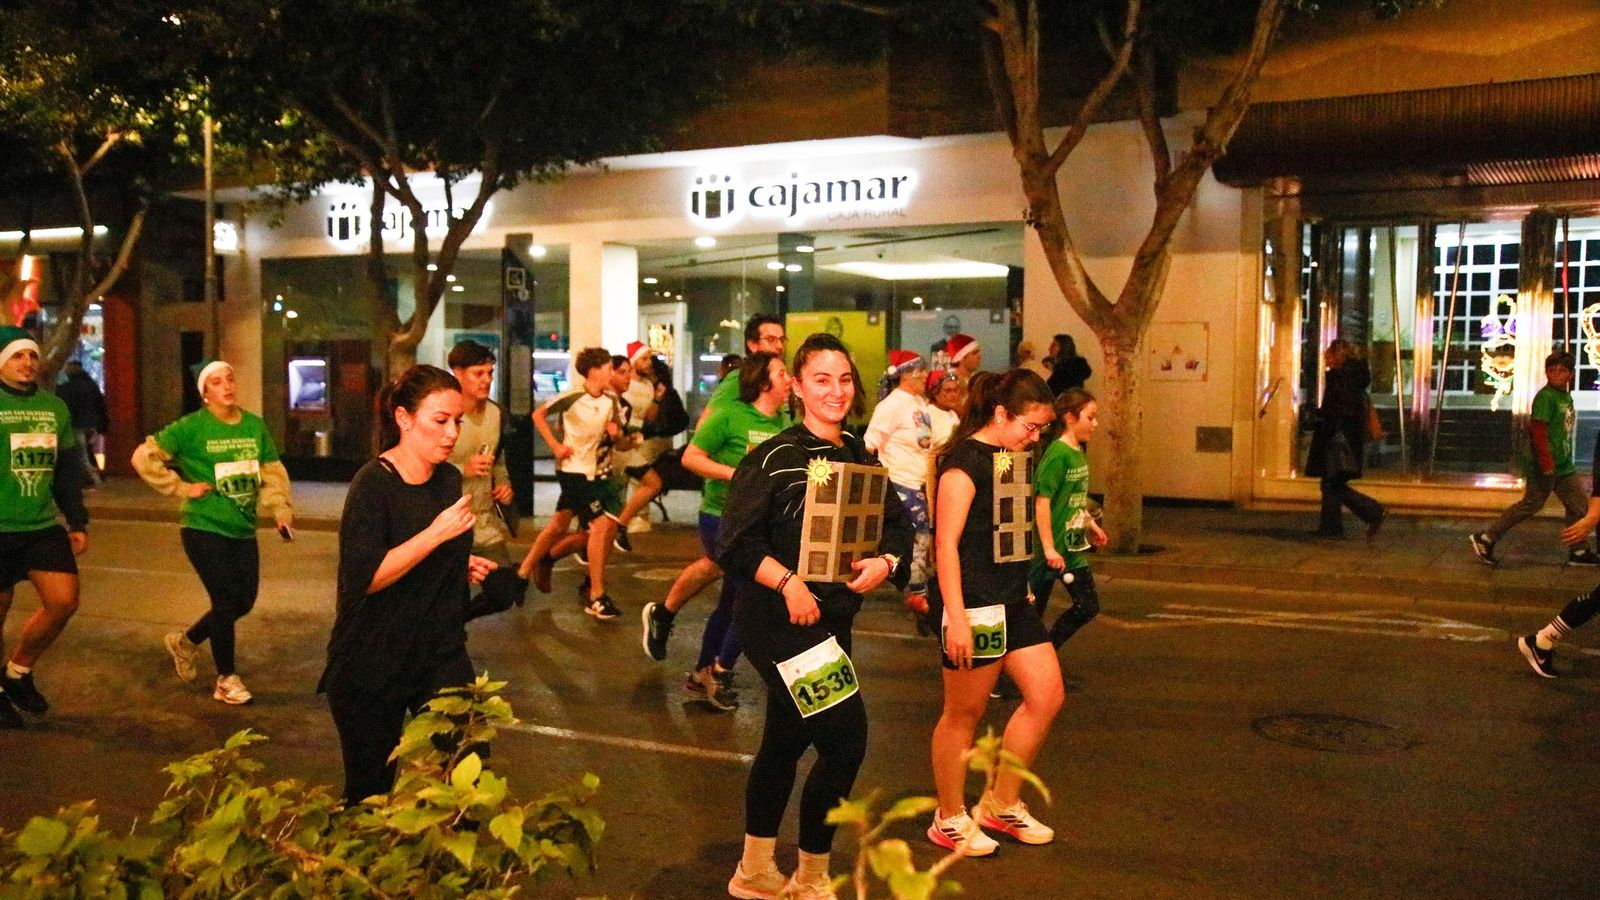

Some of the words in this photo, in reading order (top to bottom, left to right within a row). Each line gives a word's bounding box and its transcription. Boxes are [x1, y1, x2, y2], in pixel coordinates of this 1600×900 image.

[749, 172, 908, 217] cajamar
[828, 211, 859, 221] CAJA
[17, 451, 54, 465] 1172
[224, 478, 256, 492] 1171
[975, 630, 1003, 651] 05
[798, 665, 853, 705] 1538
